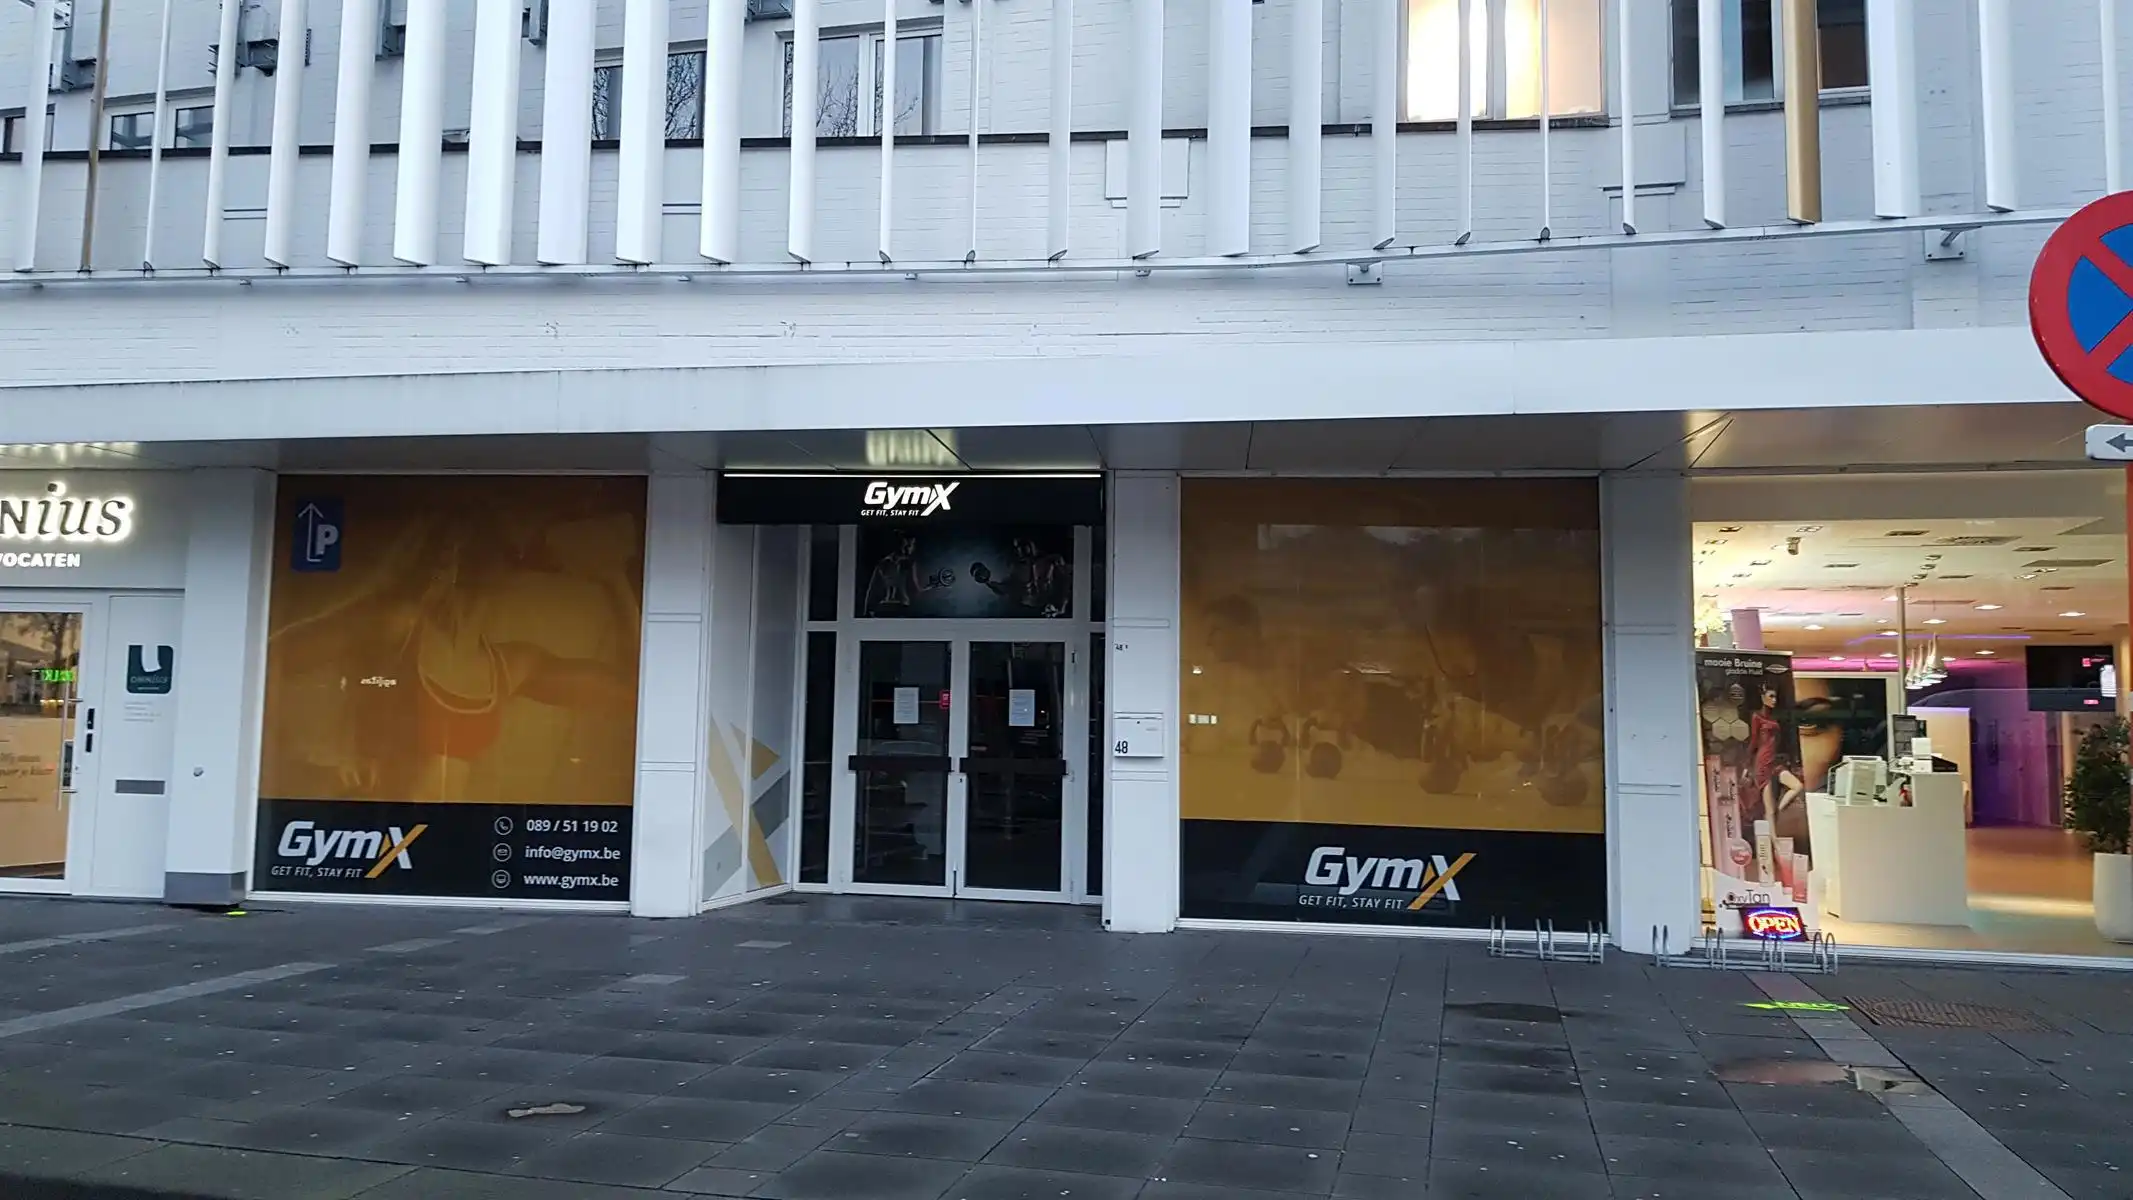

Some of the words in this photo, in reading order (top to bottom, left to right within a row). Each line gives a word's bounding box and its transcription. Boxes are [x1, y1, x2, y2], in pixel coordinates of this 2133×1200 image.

[863, 481, 960, 516] GymX
[876, 509, 889, 517] FIT,
[890, 509, 907, 517] STAY
[908, 509, 920, 517] FIT
[315, 524, 339, 556] P
[0, 552, 81, 568] OCATEN
[1115, 740, 1129, 754] 48
[526, 819, 551, 832] 089
[553, 820, 560, 832] /
[562, 820, 578, 832] 51
[583, 820, 599, 833] 19
[601, 820, 619, 833] 02
[277, 820, 429, 879] GymX
[524, 845, 621, 863] info@gymx.be
[271, 865, 293, 876] GET
[294, 867, 314, 878] FIT,
[317, 867, 342, 878] STAY
[344, 868, 363, 878] FIT
[1304, 846, 1477, 911] GymX
[523, 873, 619, 889] www.gymx.be
[1299, 894, 1323, 906] GET
[1325, 896, 1348, 908] FIT,
[1351, 897, 1380, 909] STAY
[1384, 899, 1404, 910] FIT
[1748, 916, 1801, 933] OPEN
